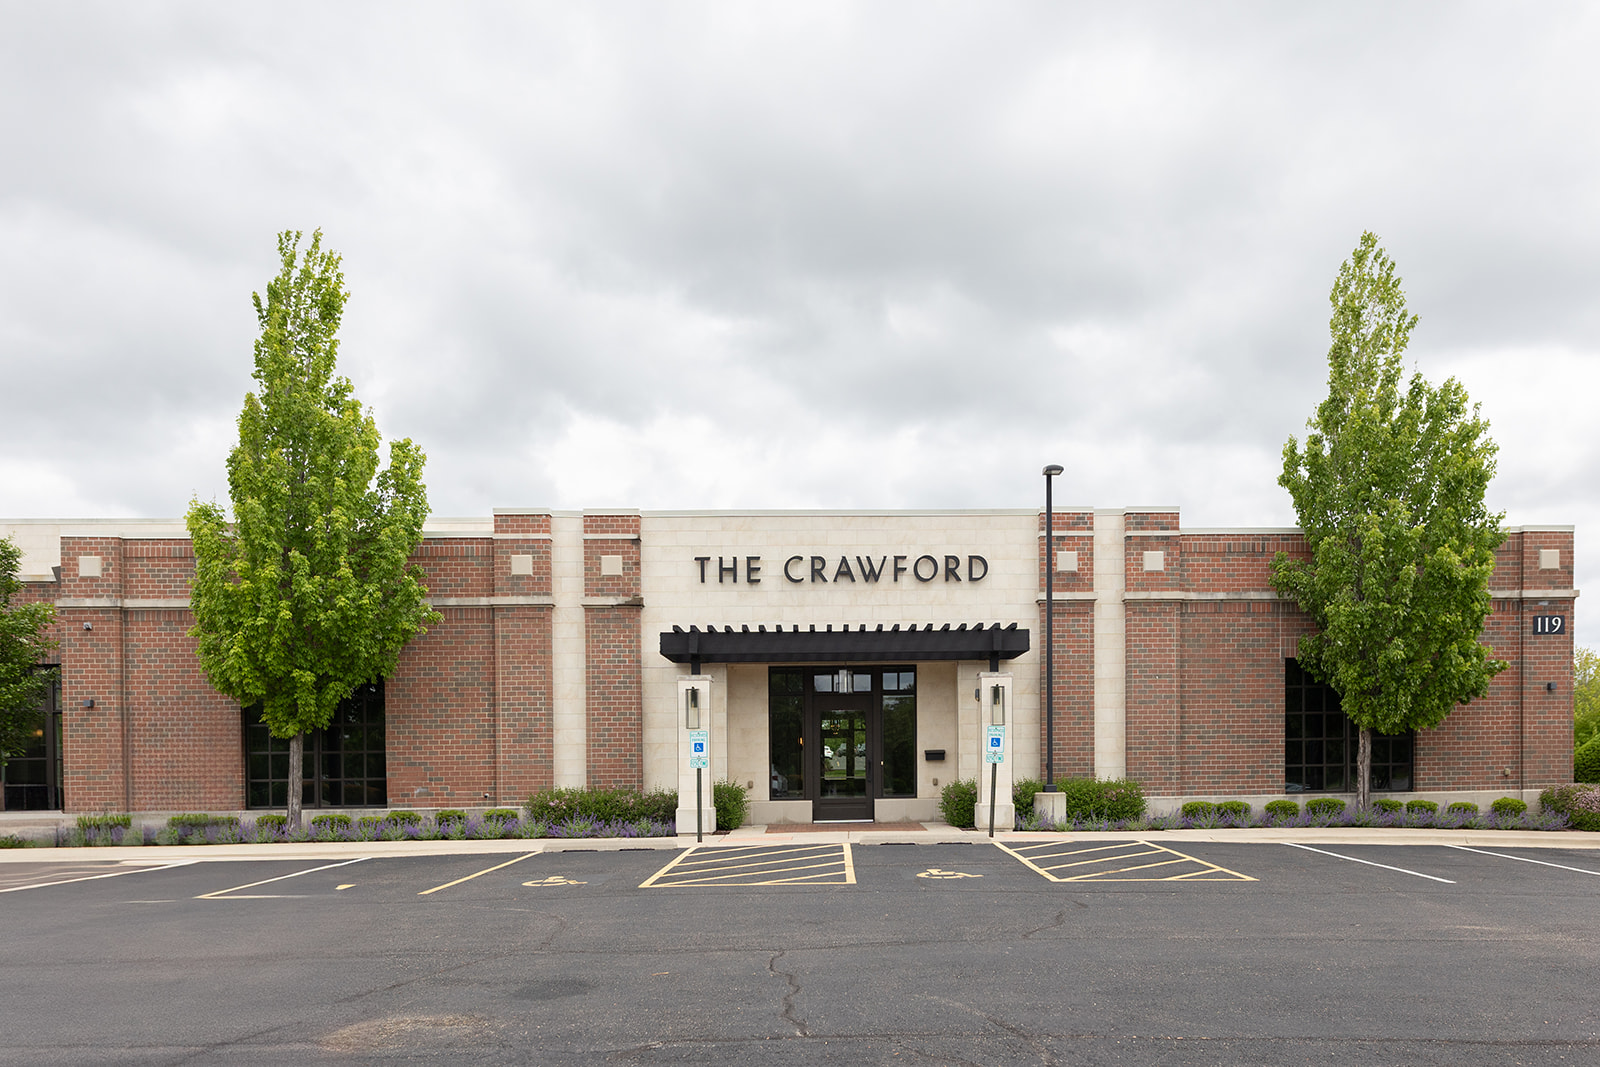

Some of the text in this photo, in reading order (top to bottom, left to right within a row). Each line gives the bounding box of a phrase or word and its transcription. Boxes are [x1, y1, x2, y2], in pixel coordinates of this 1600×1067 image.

[694, 555, 989, 583] THE CRAWFORD
[1537, 616, 1562, 633] 119
